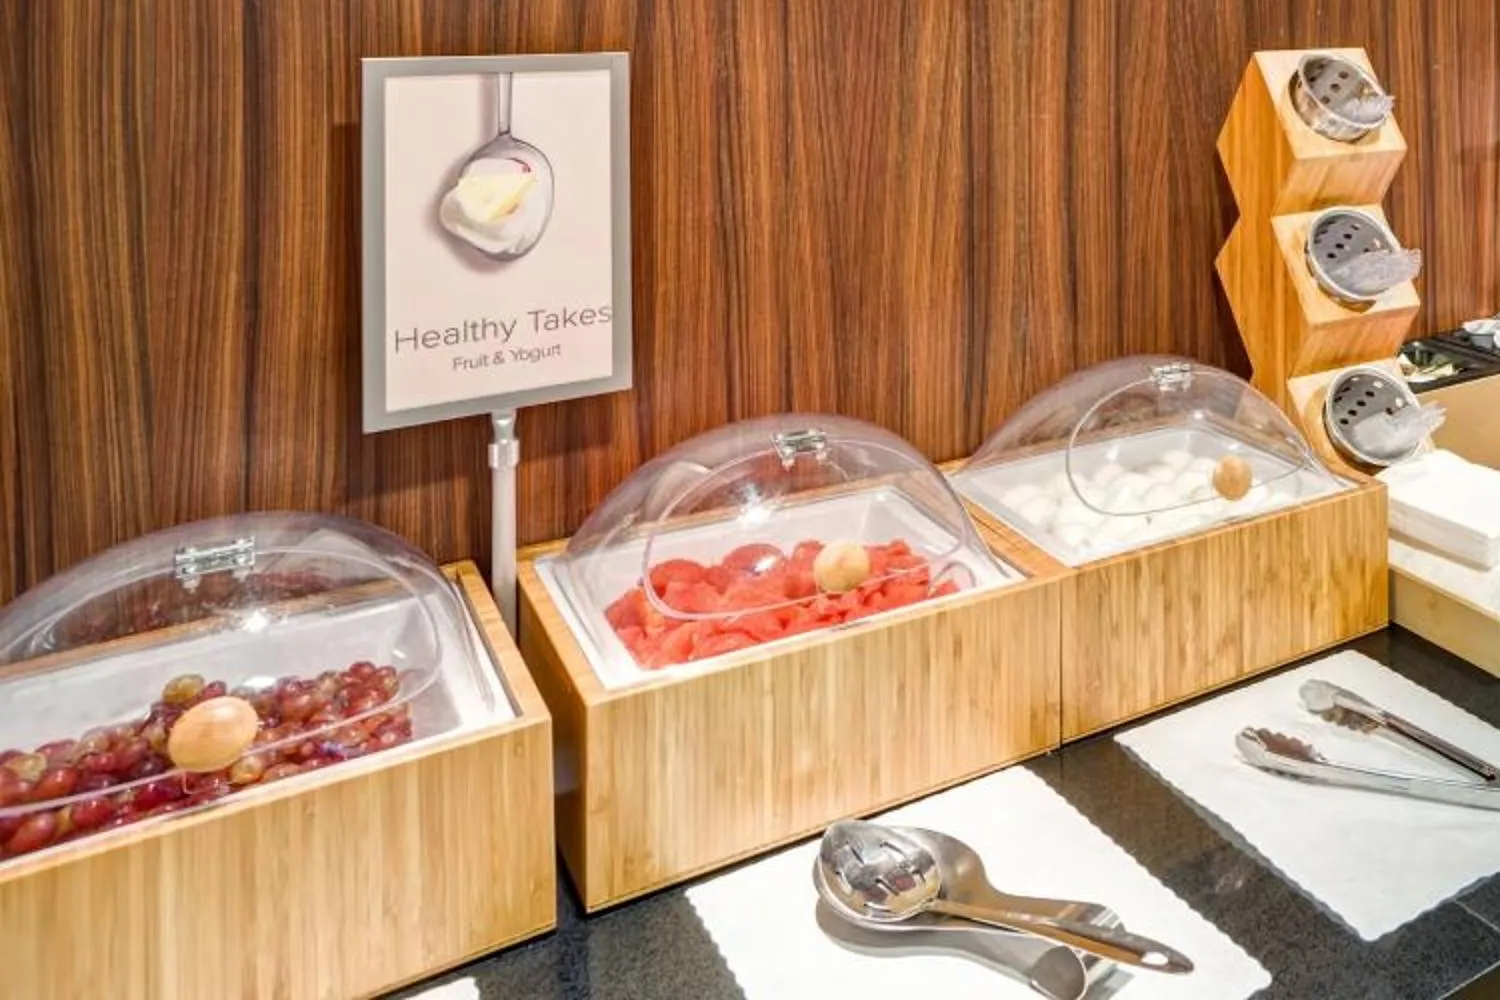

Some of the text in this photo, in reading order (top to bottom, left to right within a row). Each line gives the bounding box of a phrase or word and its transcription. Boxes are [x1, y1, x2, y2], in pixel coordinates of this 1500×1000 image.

[394, 304, 613, 354] Healthy Takes
[452, 343, 562, 371] Fruit & Yogurt
